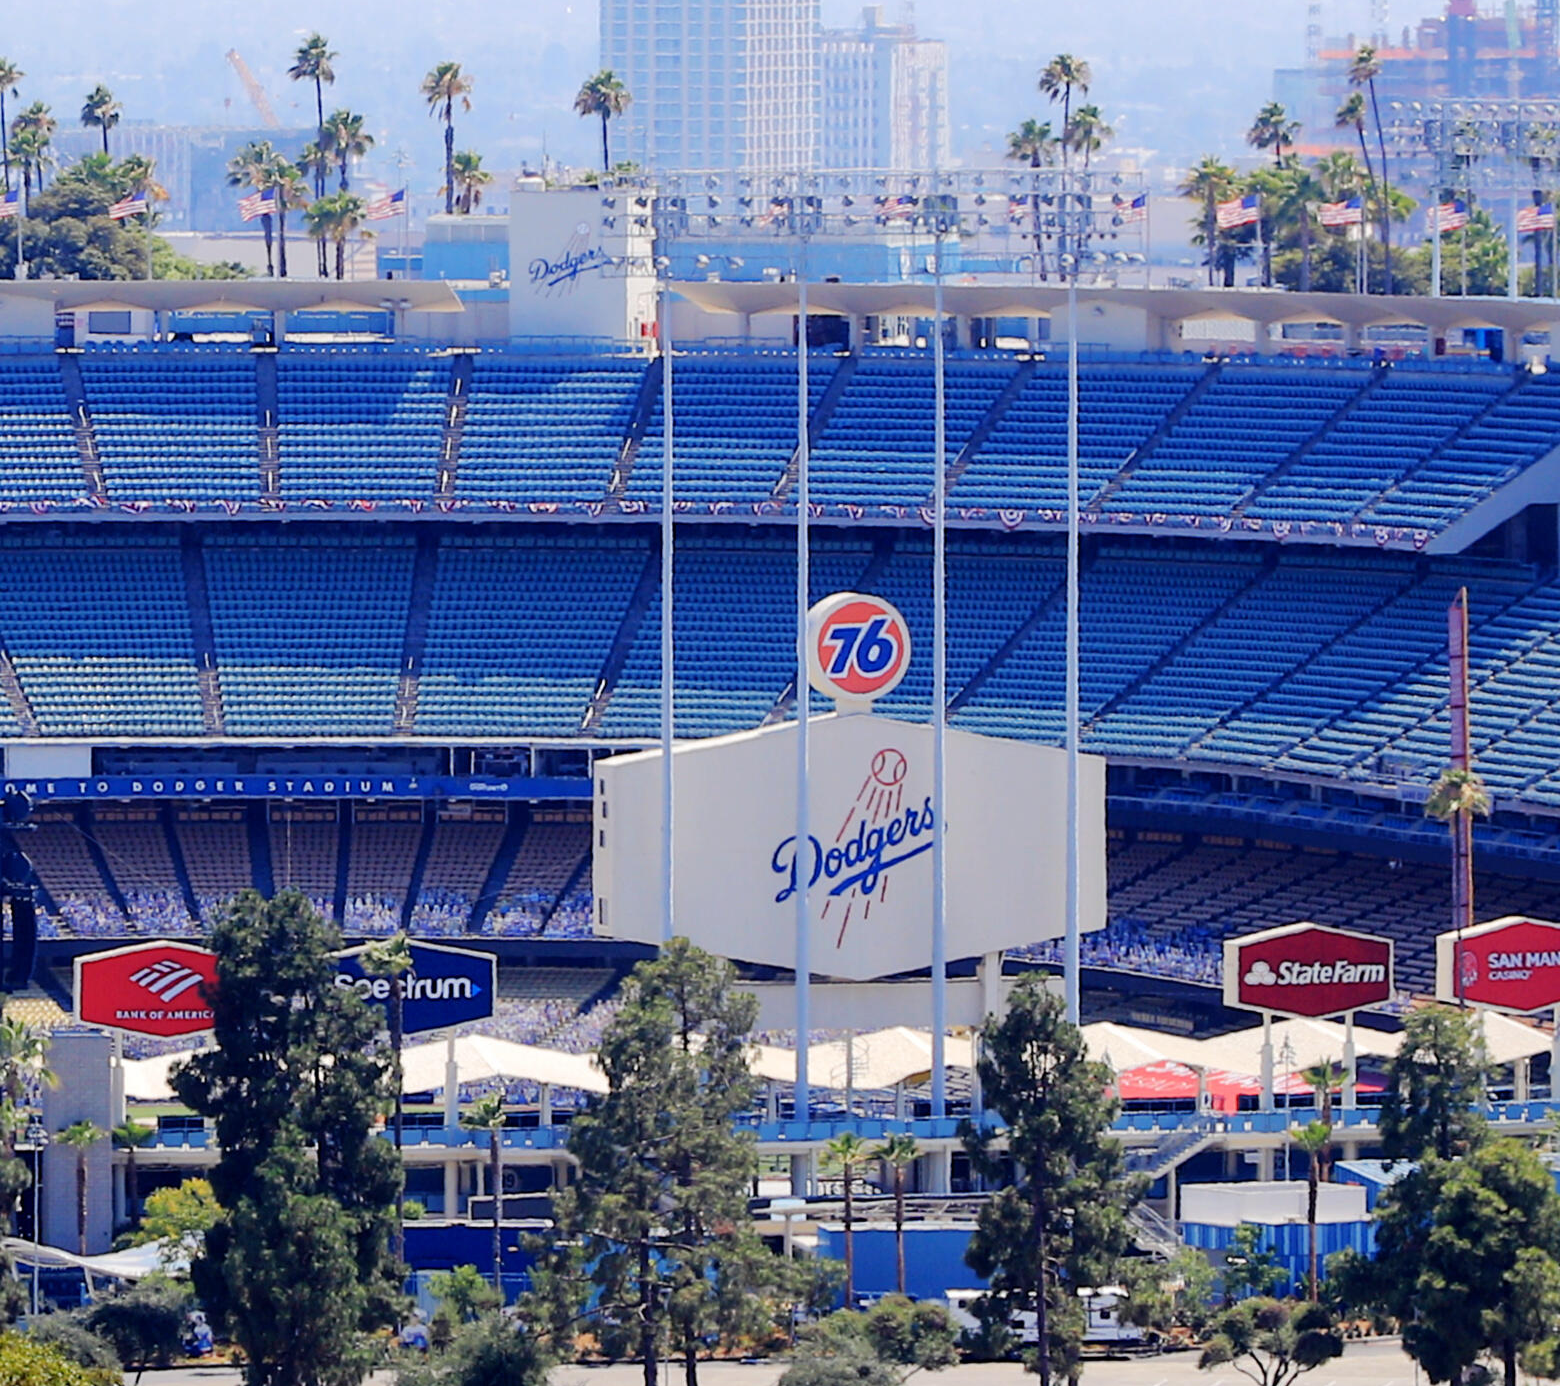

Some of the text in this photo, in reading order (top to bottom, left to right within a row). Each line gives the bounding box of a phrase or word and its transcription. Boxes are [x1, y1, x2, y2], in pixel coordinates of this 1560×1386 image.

[826, 616, 896, 676] 76
[79, 781, 109, 794] TO
[132, 780, 244, 794] DODGER
[267, 780, 394, 793] STADIUM
[771, 796, 948, 903] Dodgers
[1488, 952, 1523, 969] SAN
[1488, 969, 1530, 981] CASINO
[115, 1010, 147, 1019] BANK
[149, 1010, 164, 1020] OF
